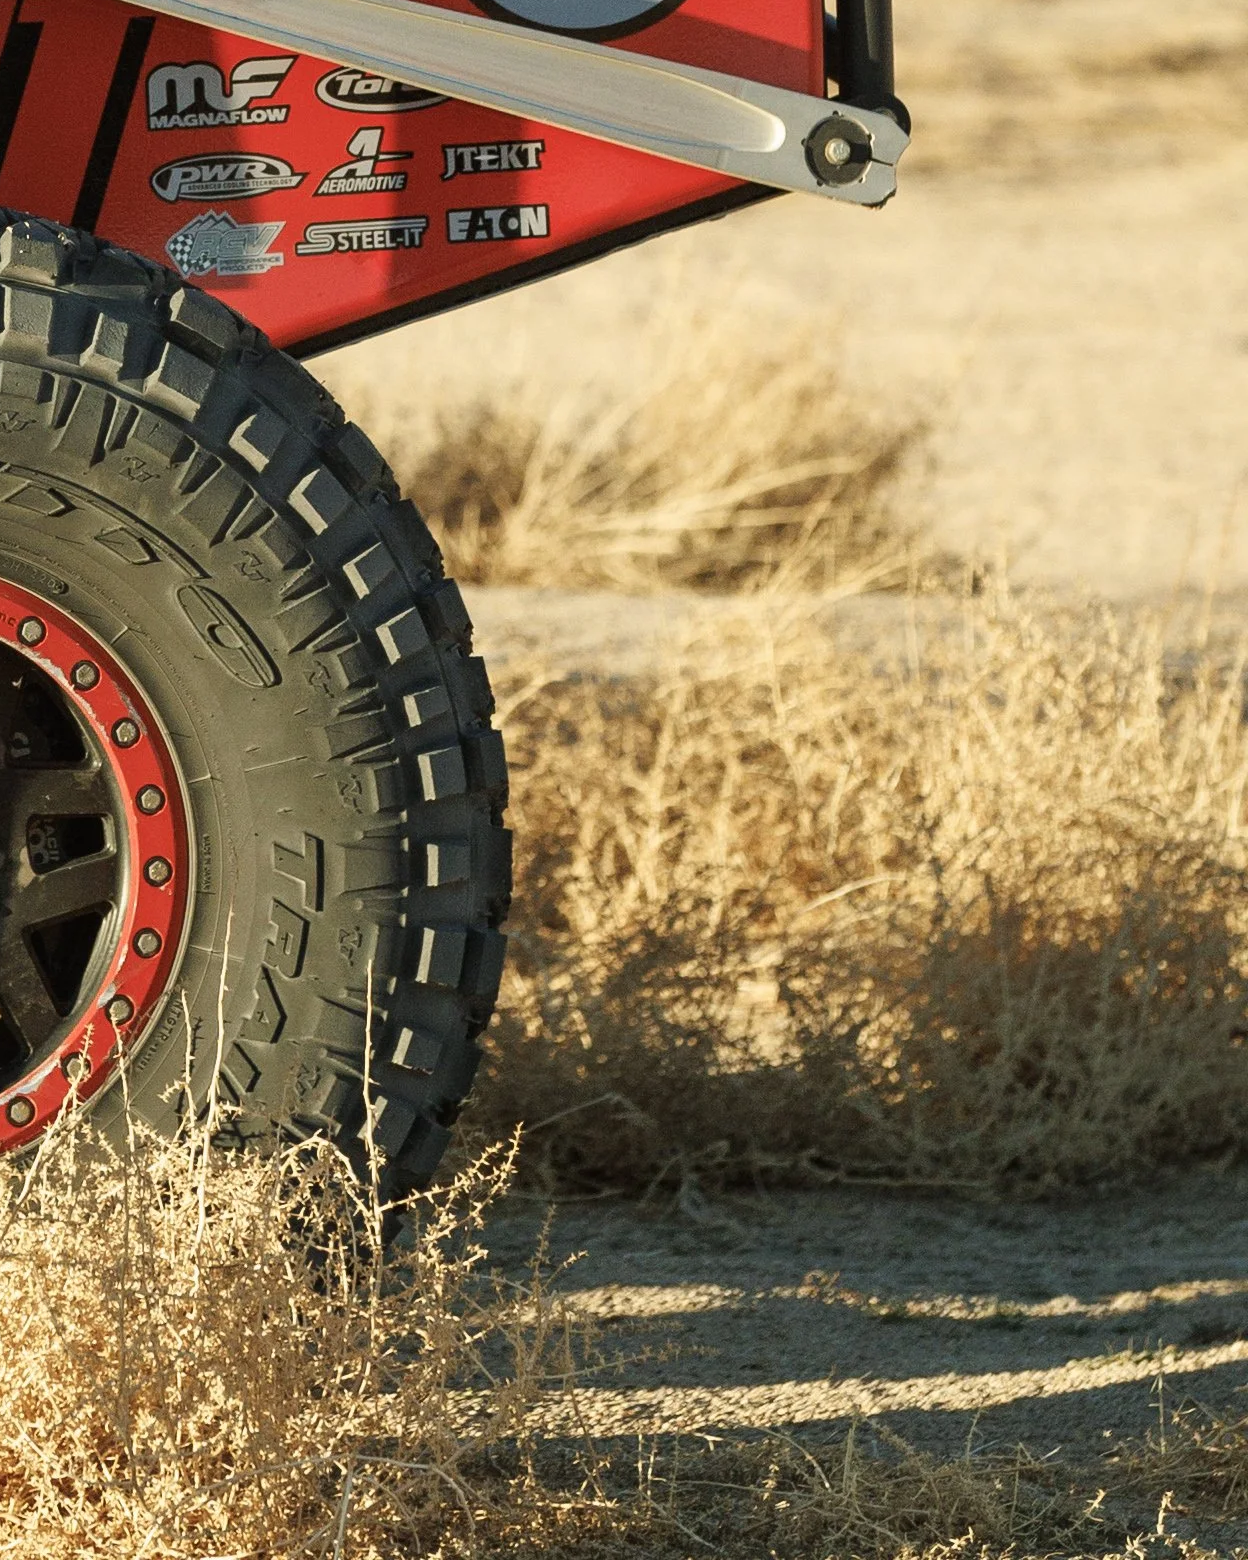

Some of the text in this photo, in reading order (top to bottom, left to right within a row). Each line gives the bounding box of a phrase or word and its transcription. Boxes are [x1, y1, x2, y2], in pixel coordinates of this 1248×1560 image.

[149, 107, 288, 130] MAGNAFLOW
[444, 142, 543, 179] JTEKT
[187, 178, 294, 191] ADVANCED COOLING TECHNOLOGY
[318, 174, 405, 194] AEROMOTIVE
[448, 206, 548, 241] EATON
[337, 227, 426, 251] STEEL-IT
